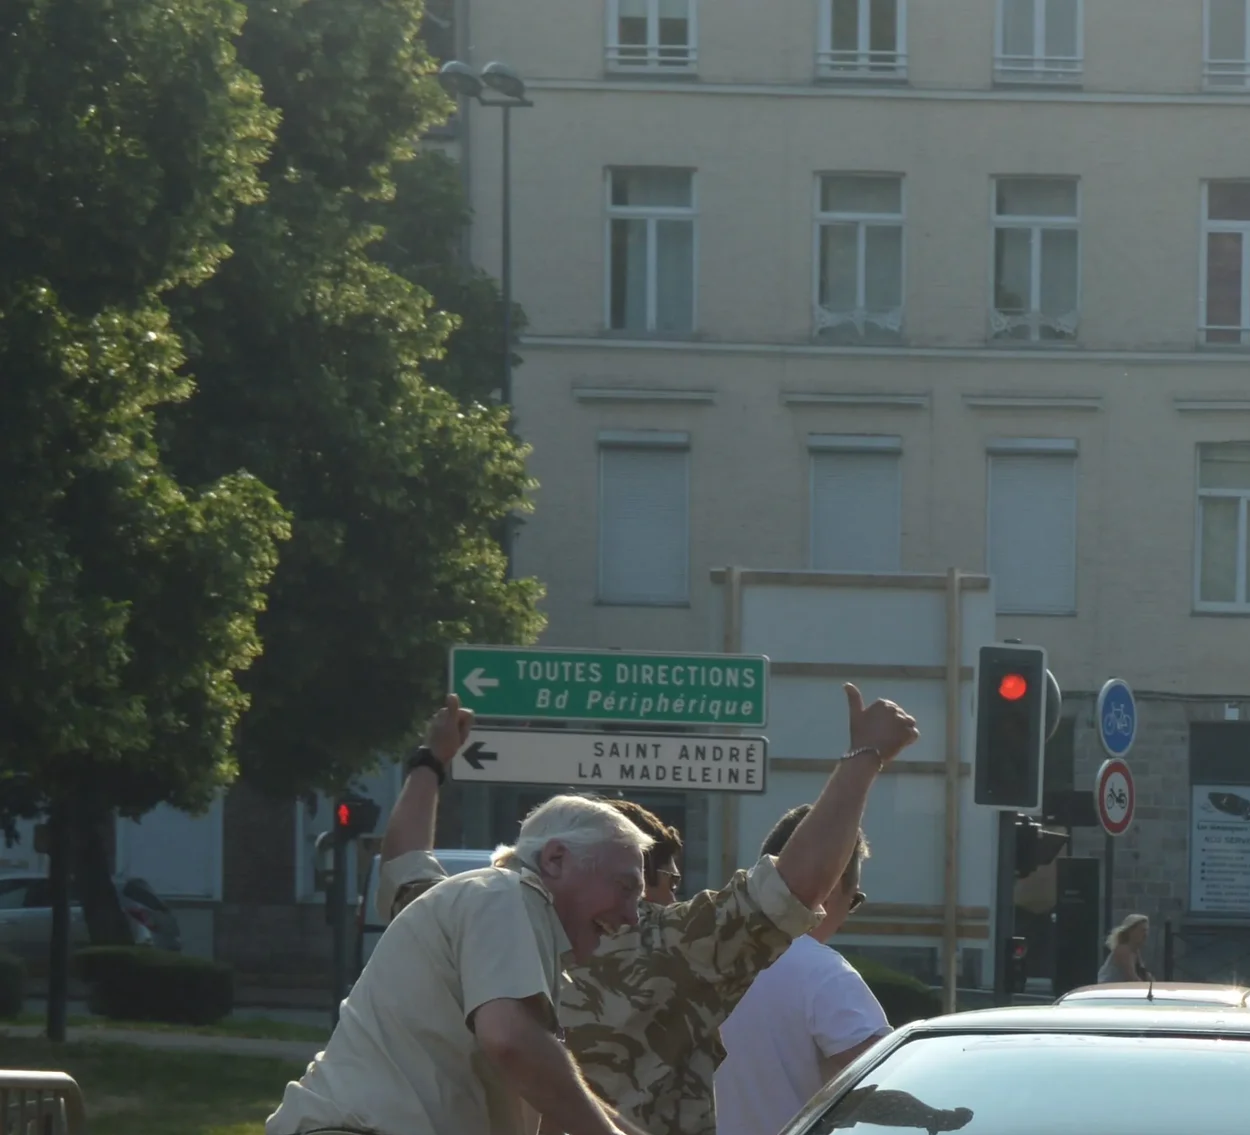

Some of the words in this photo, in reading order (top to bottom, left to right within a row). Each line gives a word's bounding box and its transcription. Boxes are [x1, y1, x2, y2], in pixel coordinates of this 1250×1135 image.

[516, 659, 603, 683] TOUTES
[616, 662, 756, 688] DIRECTIONS
[536, 687, 569, 710] Bd
[587, 689, 754, 720] Périphérique
[593, 741, 662, 759] SAINT
[678, 743, 757, 763] ANDRÉ
[578, 762, 603, 779] LA
[620, 764, 757, 785] MADELEINE
